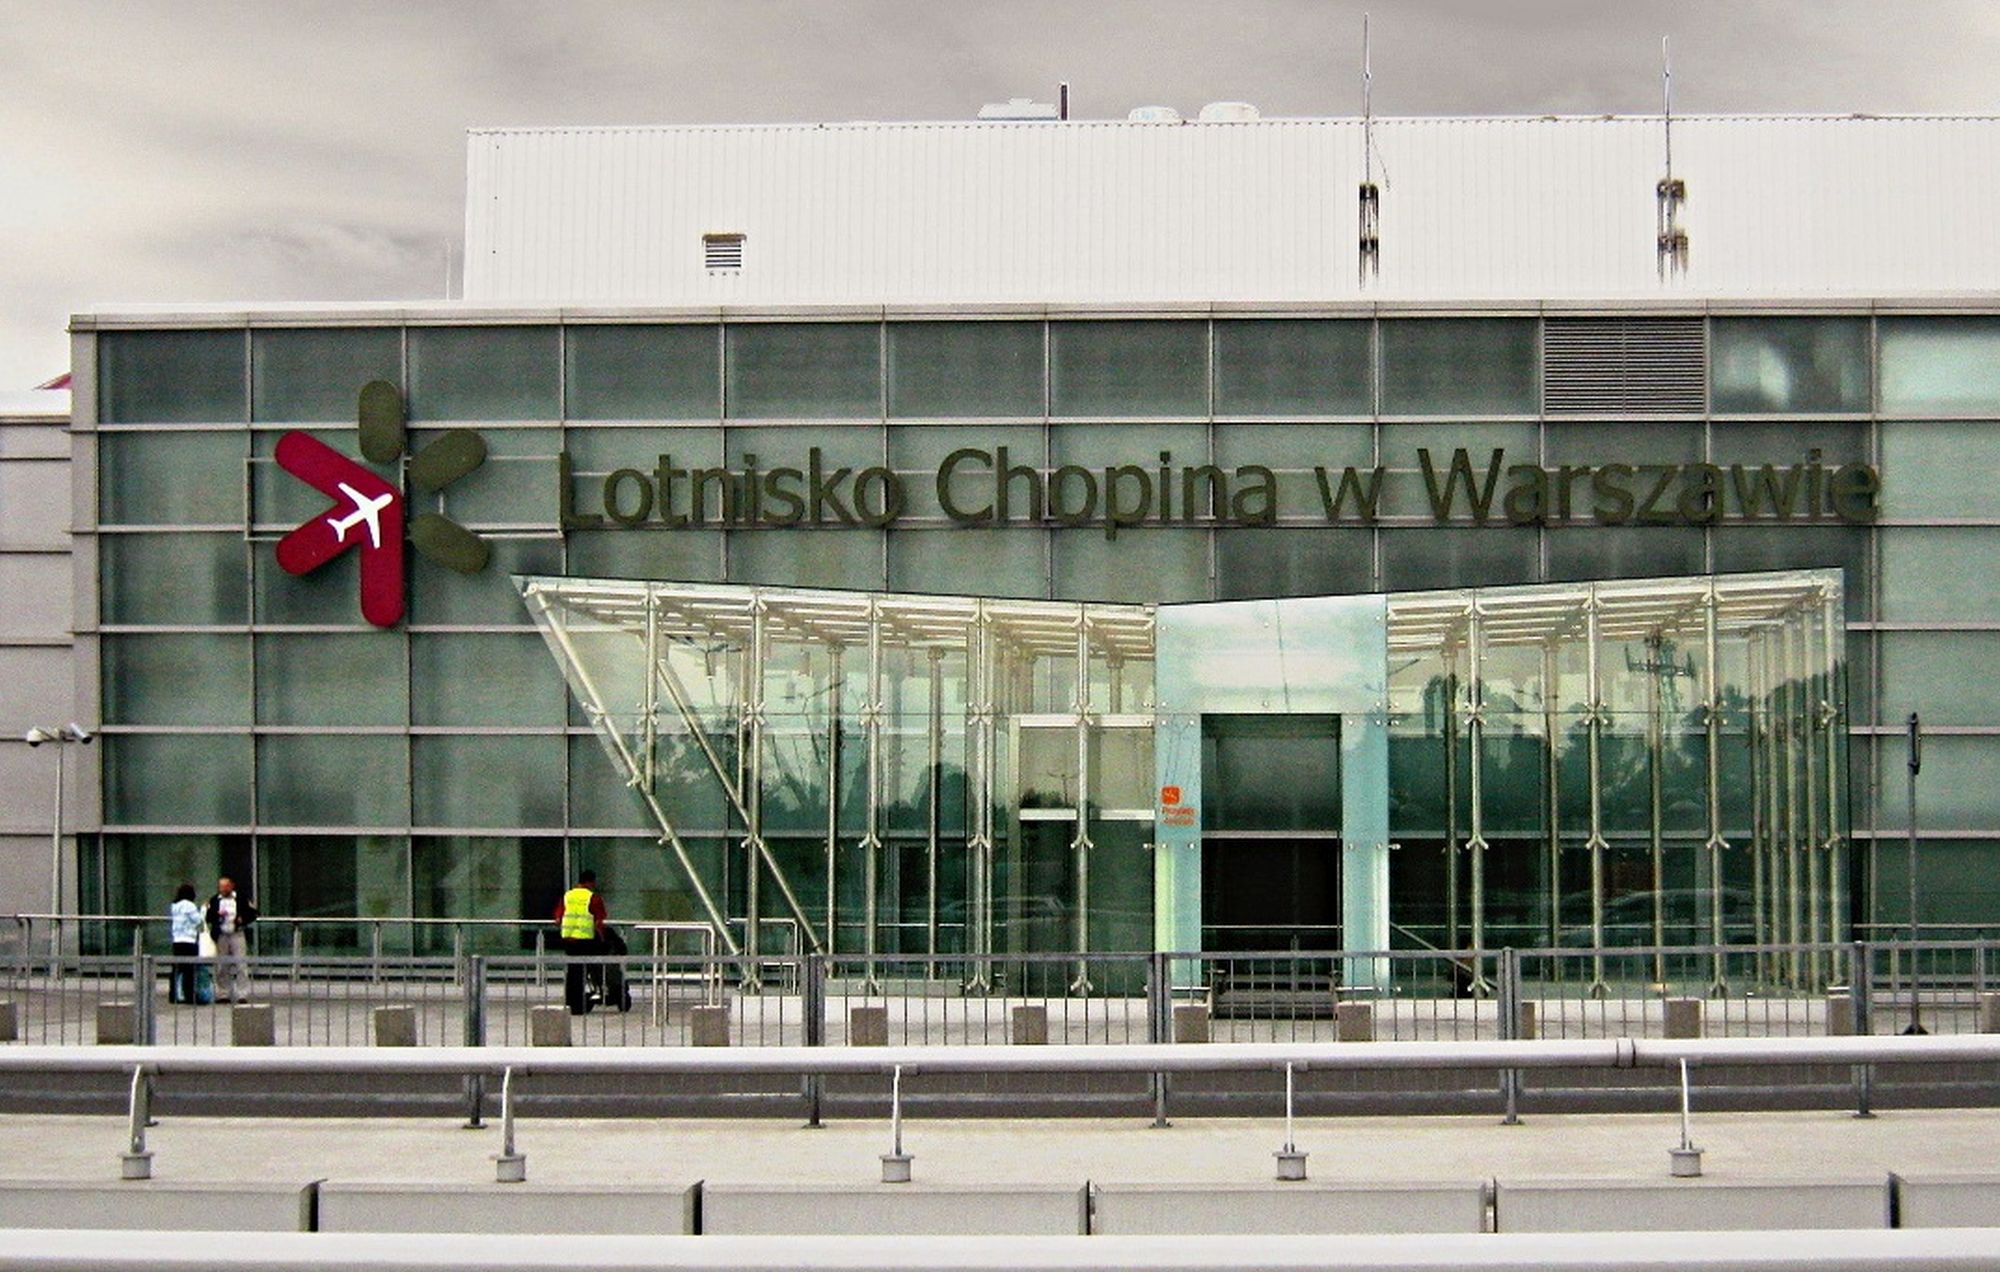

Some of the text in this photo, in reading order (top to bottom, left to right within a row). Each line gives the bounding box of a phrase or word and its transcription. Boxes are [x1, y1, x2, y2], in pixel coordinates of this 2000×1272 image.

[559, 445, 1881, 541] Lotnisko Chopina w Warszawie
